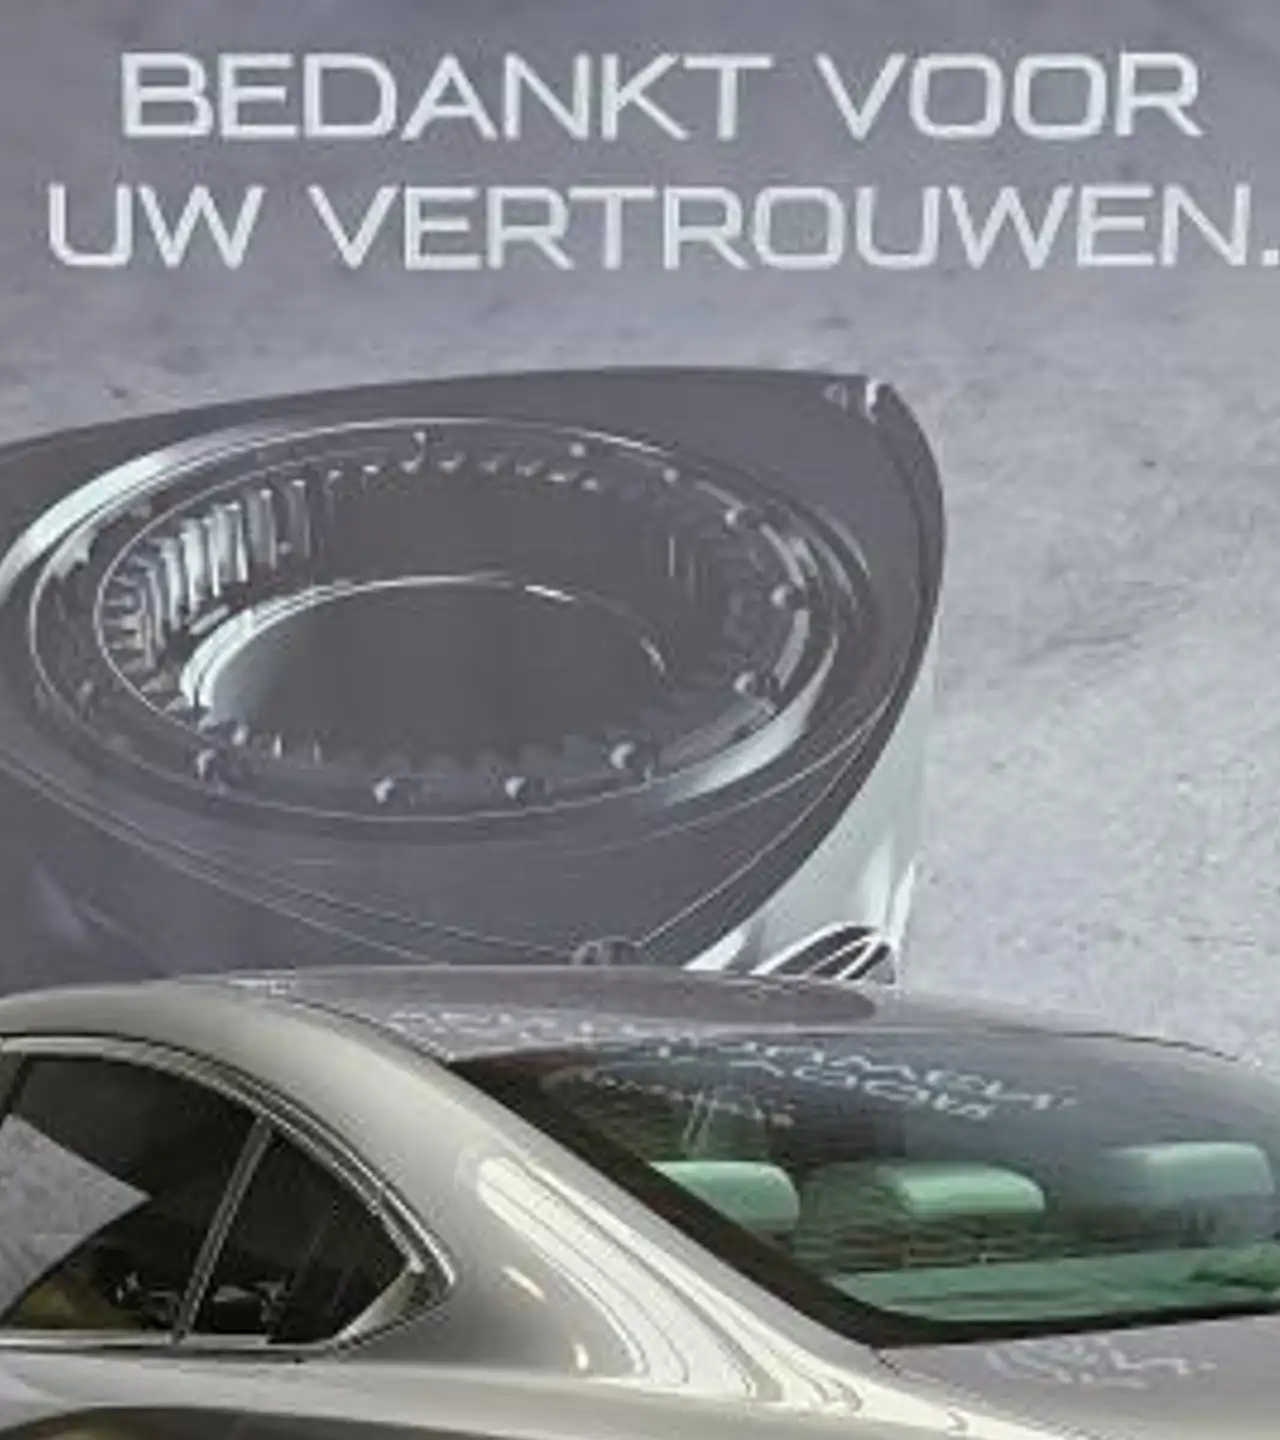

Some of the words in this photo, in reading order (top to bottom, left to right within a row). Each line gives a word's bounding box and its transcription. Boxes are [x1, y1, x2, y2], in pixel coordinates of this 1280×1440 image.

[122, 52, 773, 140] BEDANKT
[816, 52, 1201, 140] VOOR
[46, 184, 264, 270] UW
